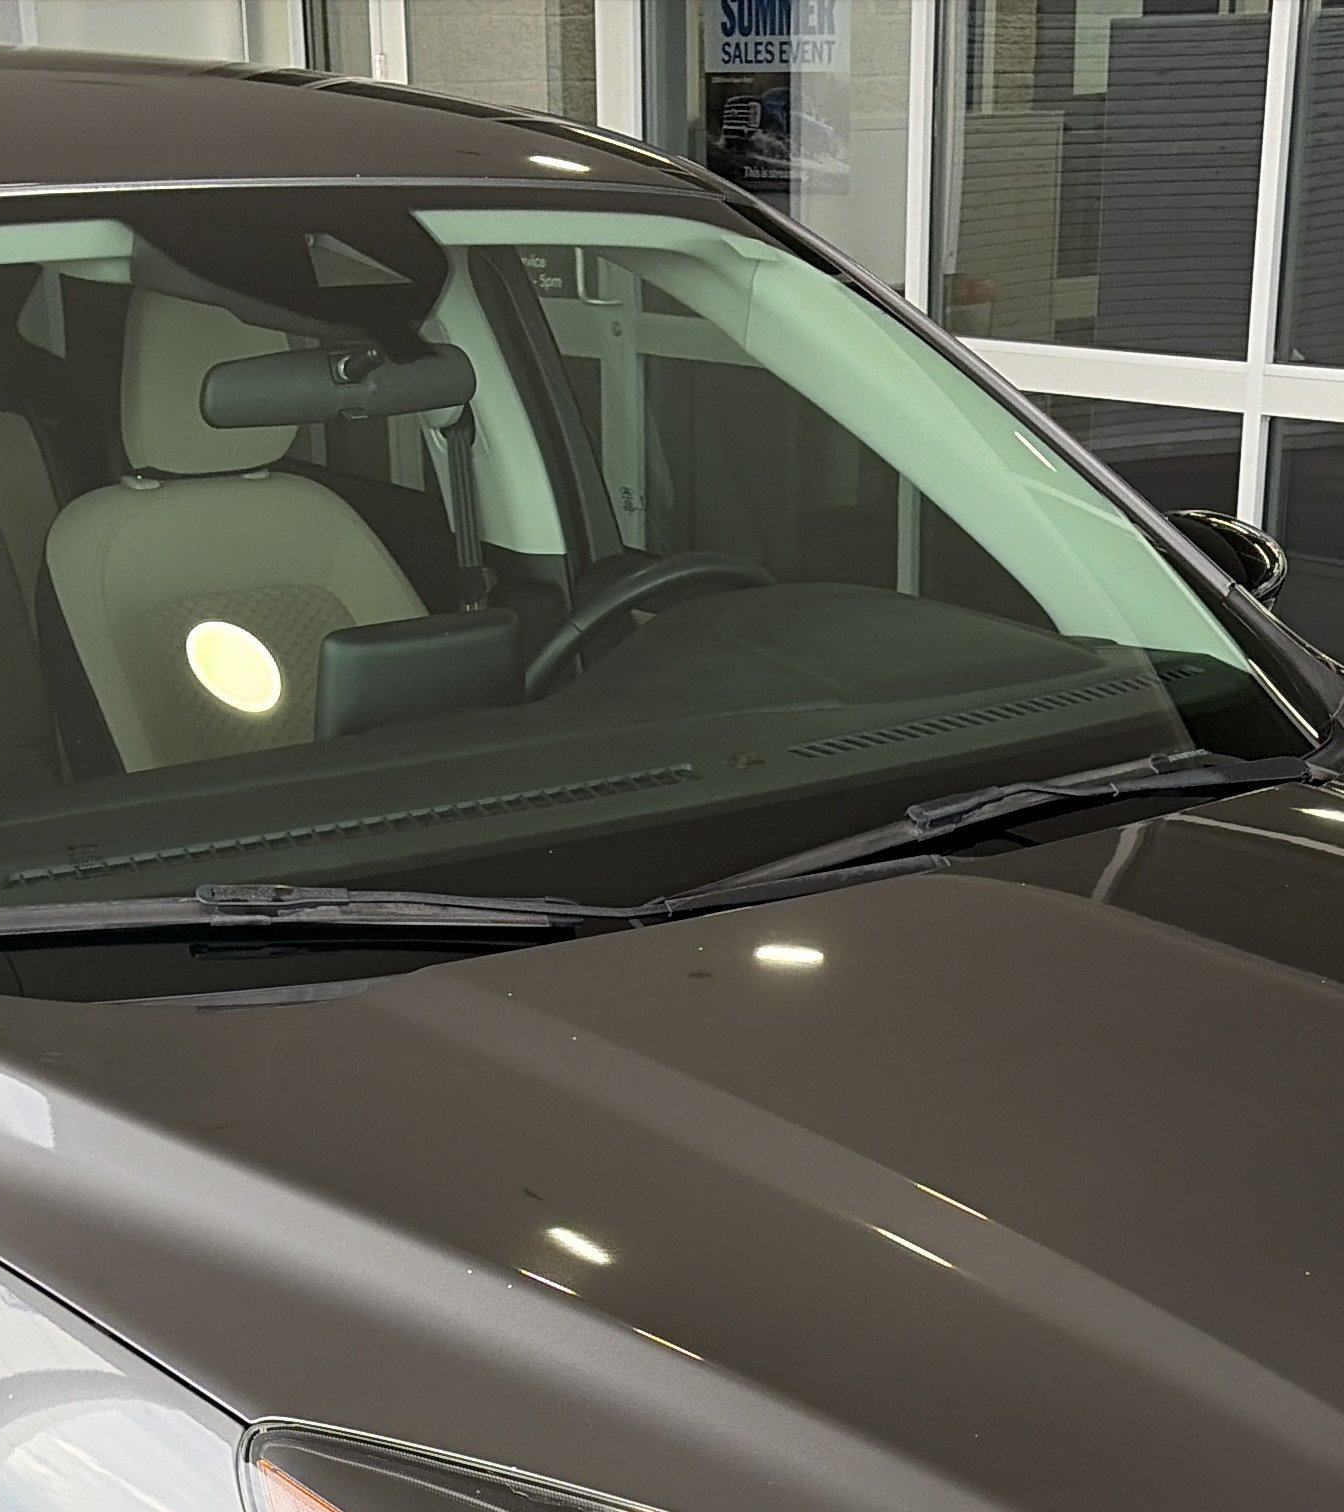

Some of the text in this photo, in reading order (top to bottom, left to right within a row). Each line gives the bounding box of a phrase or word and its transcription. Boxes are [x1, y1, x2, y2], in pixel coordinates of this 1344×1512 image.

[720, 0, 835, 38] SUMMER
[721, 41, 836, 64] SALES EVENT
